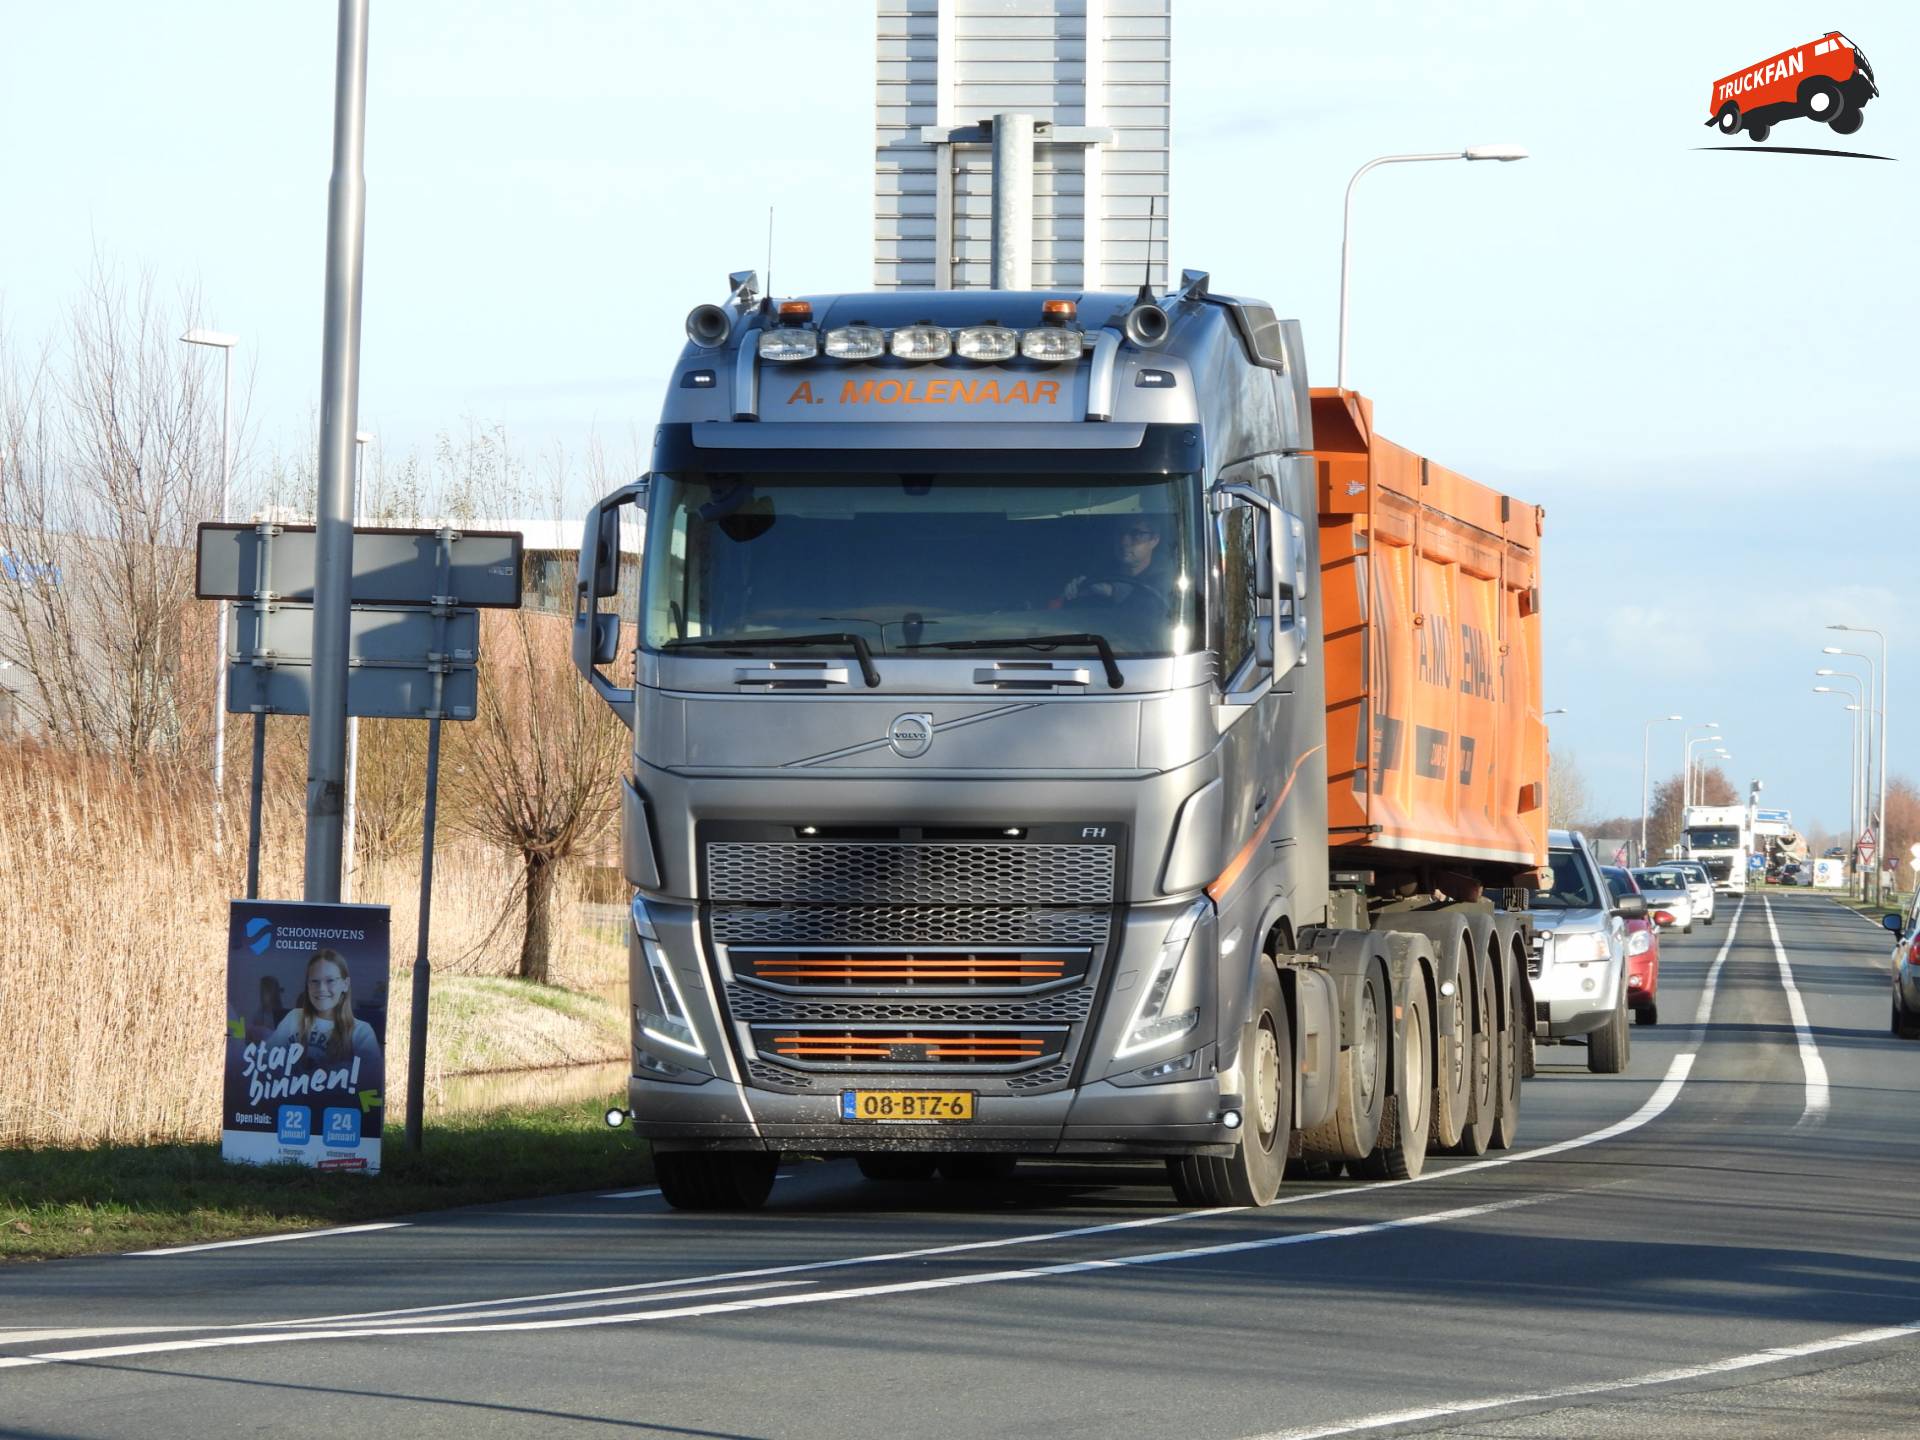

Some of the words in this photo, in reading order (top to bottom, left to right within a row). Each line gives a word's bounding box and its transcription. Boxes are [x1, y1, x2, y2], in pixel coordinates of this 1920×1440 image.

[787, 381, 824, 405] A.
[839, 379, 1061, 405] MOLENAAR
[1082, 827, 1106, 838] FH
[276, 926, 365, 940] SCHOONHOVENS
[275, 939, 318, 950] COLLEGE
[249, 1056, 361, 1106] binnen!
[864, 1095, 964, 1116] 08-BTZ-6
[235, 1112, 253, 1125] Open
[253, 1113, 273, 1125] Huis:
[285, 1110, 303, 1129] 22
[332, 1113, 353, 1131] 24
